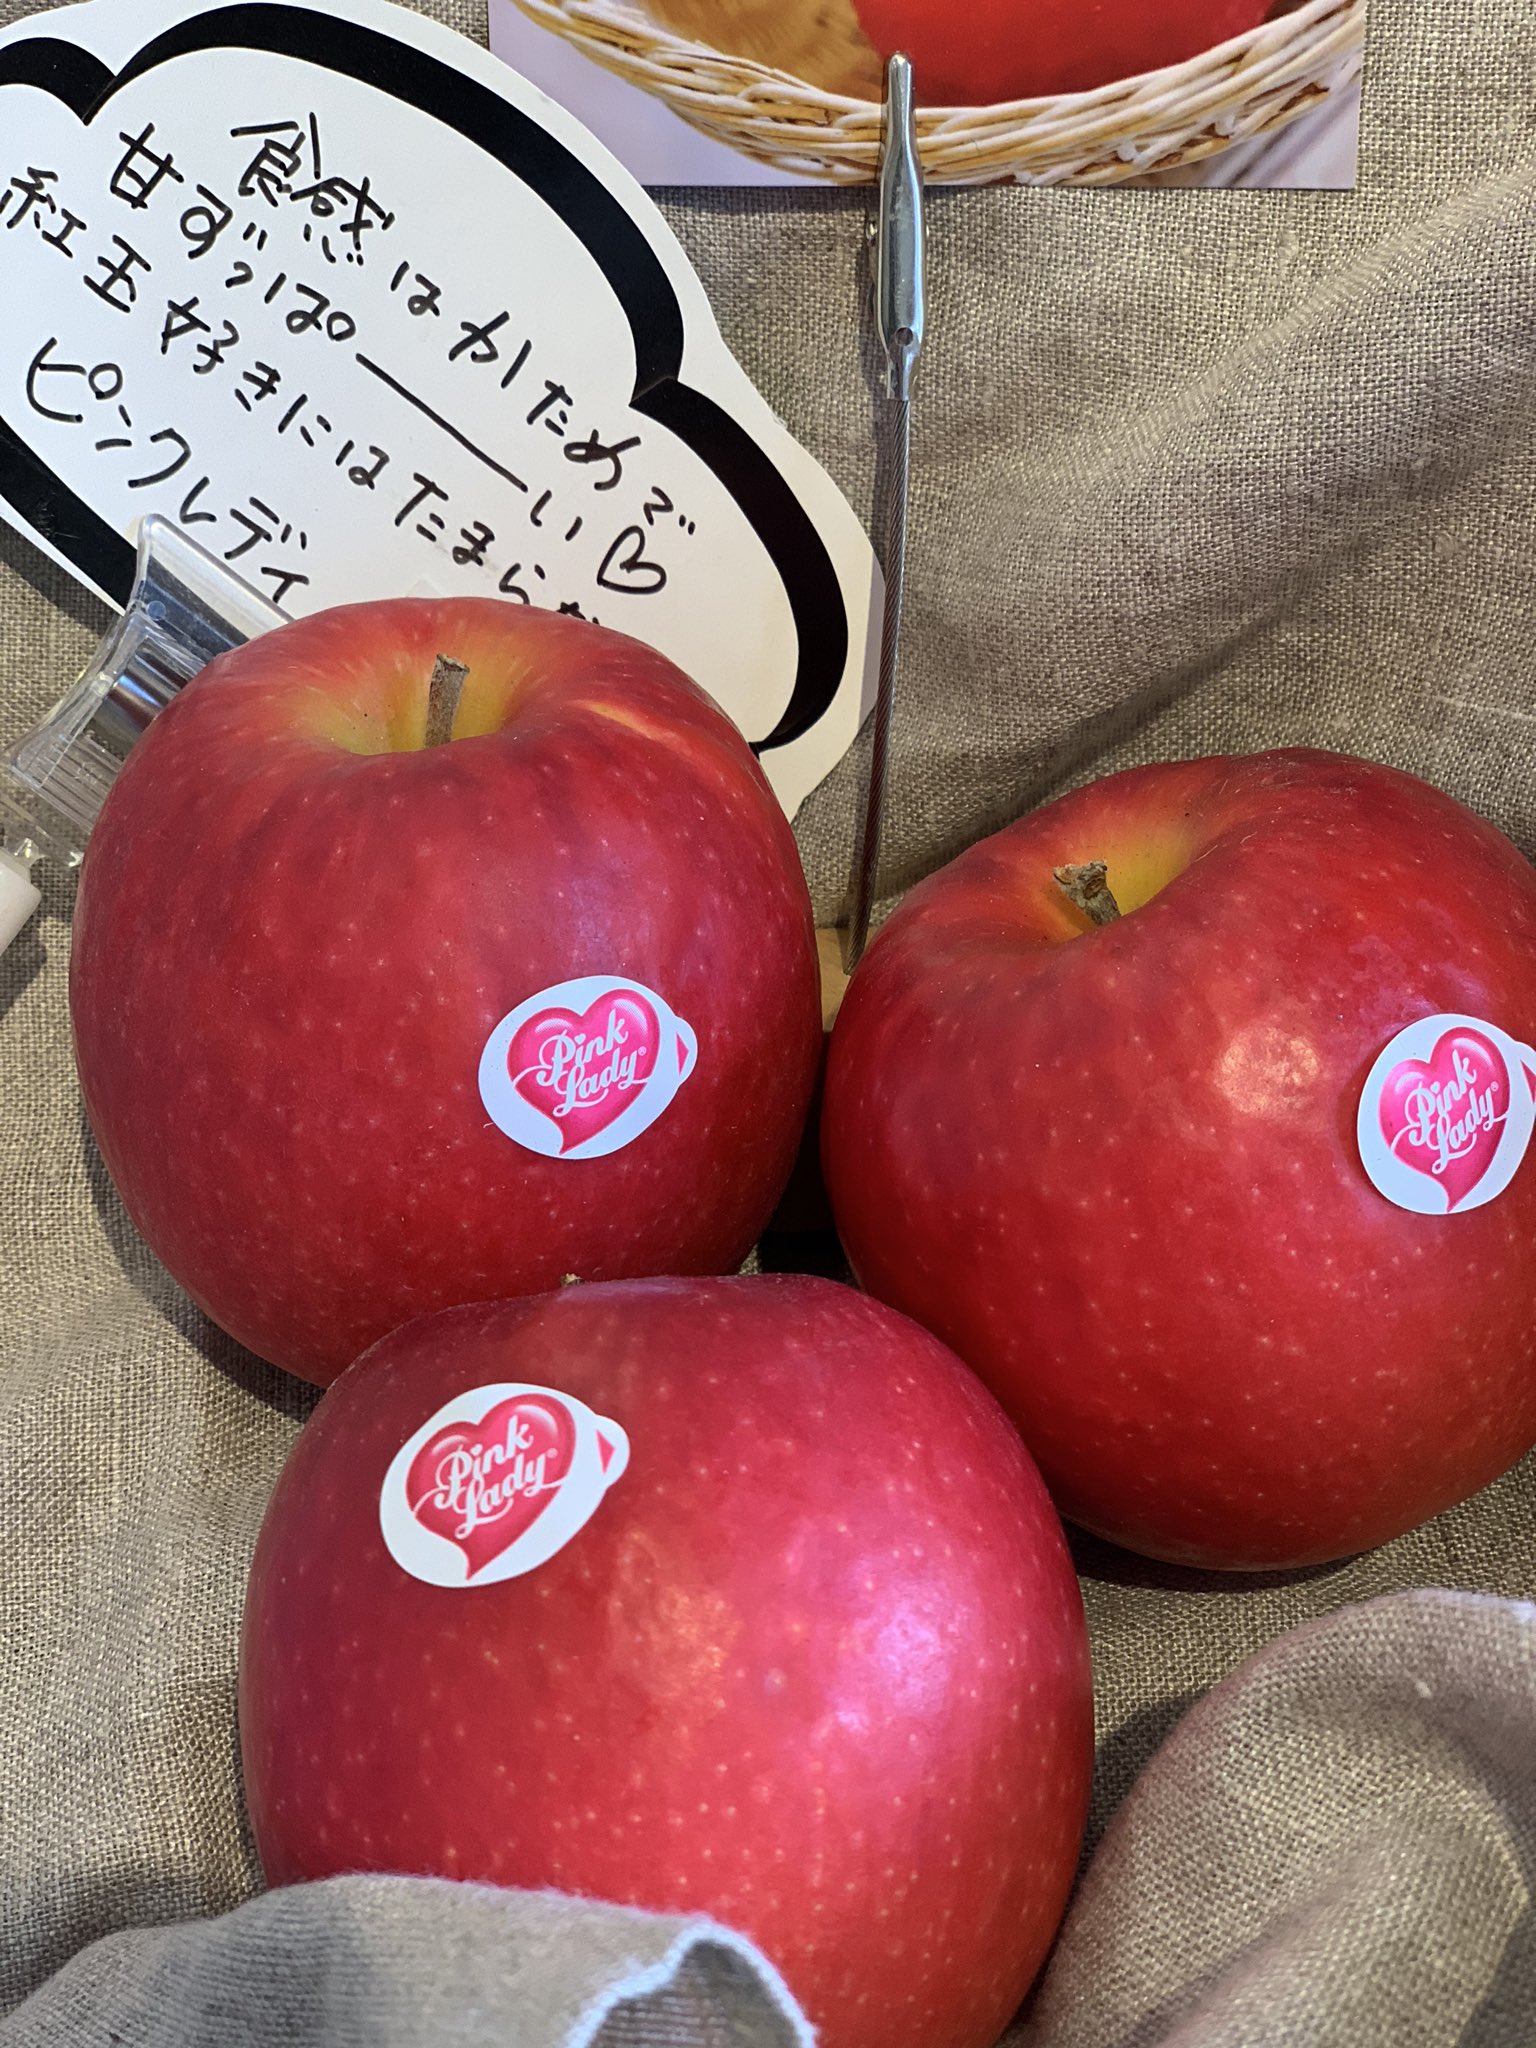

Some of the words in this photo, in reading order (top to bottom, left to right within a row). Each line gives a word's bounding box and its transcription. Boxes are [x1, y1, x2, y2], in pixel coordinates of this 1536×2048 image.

[536, 1008, 629, 1085] Pink
[1404, 1049, 1477, 1146] Pink
[434, 1415, 534, 1509] Pink
